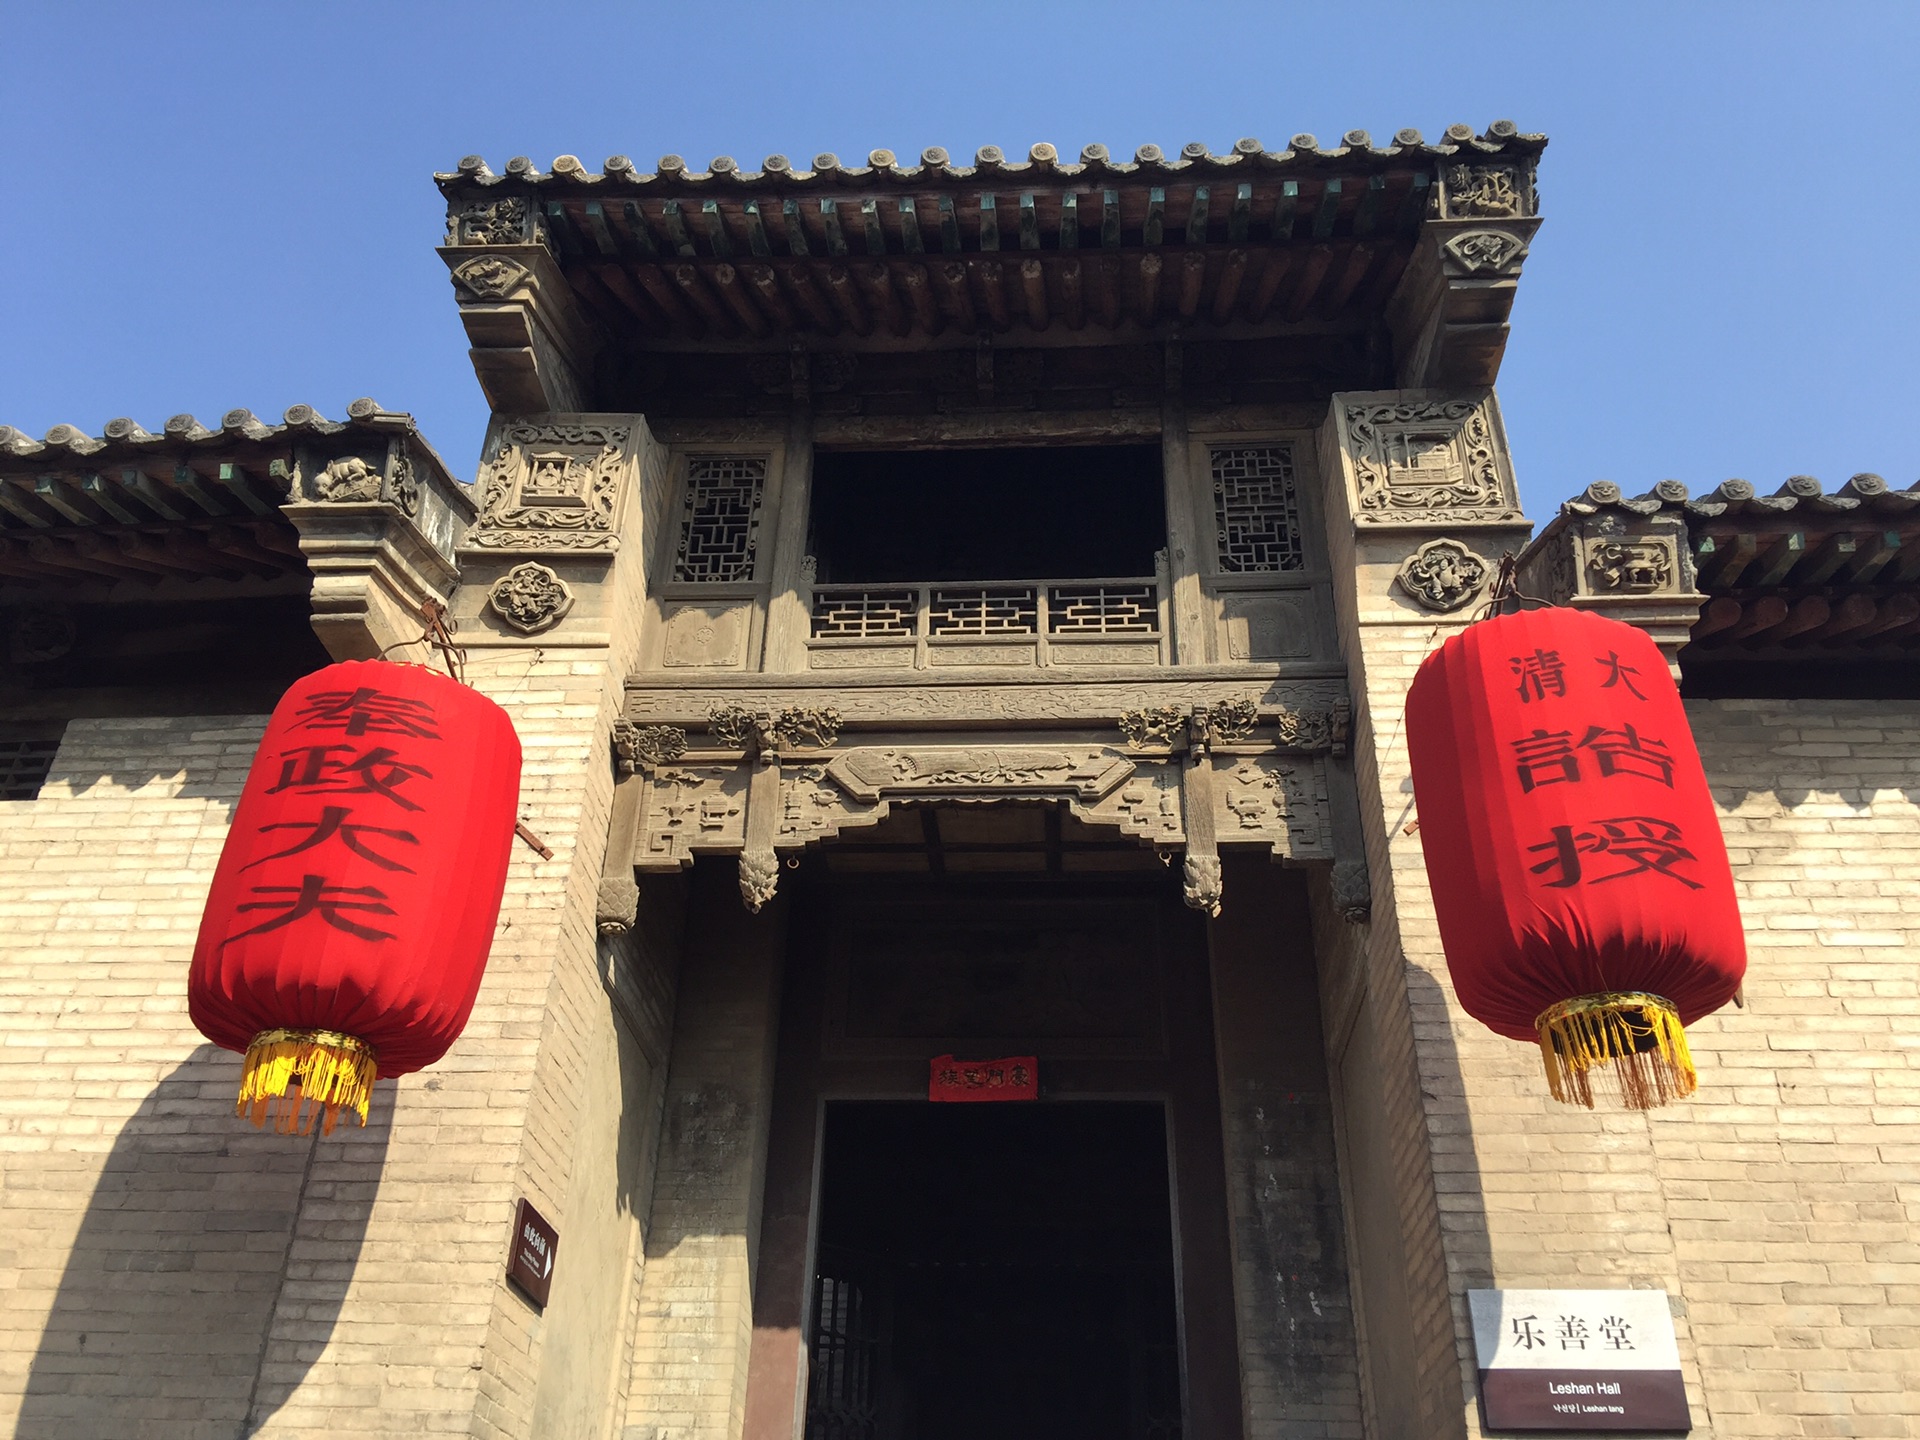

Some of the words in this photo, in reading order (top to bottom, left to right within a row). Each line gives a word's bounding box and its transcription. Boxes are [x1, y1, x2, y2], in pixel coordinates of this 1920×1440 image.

[217, 687, 443, 950] 奉政大夫
[1511, 1314, 1636, 1351] 乐善堂
[1549, 1381, 1595, 1395] Leshan
[1596, 1381, 1621, 1395] Hall
[1582, 1404, 1608, 1413] Leshan
